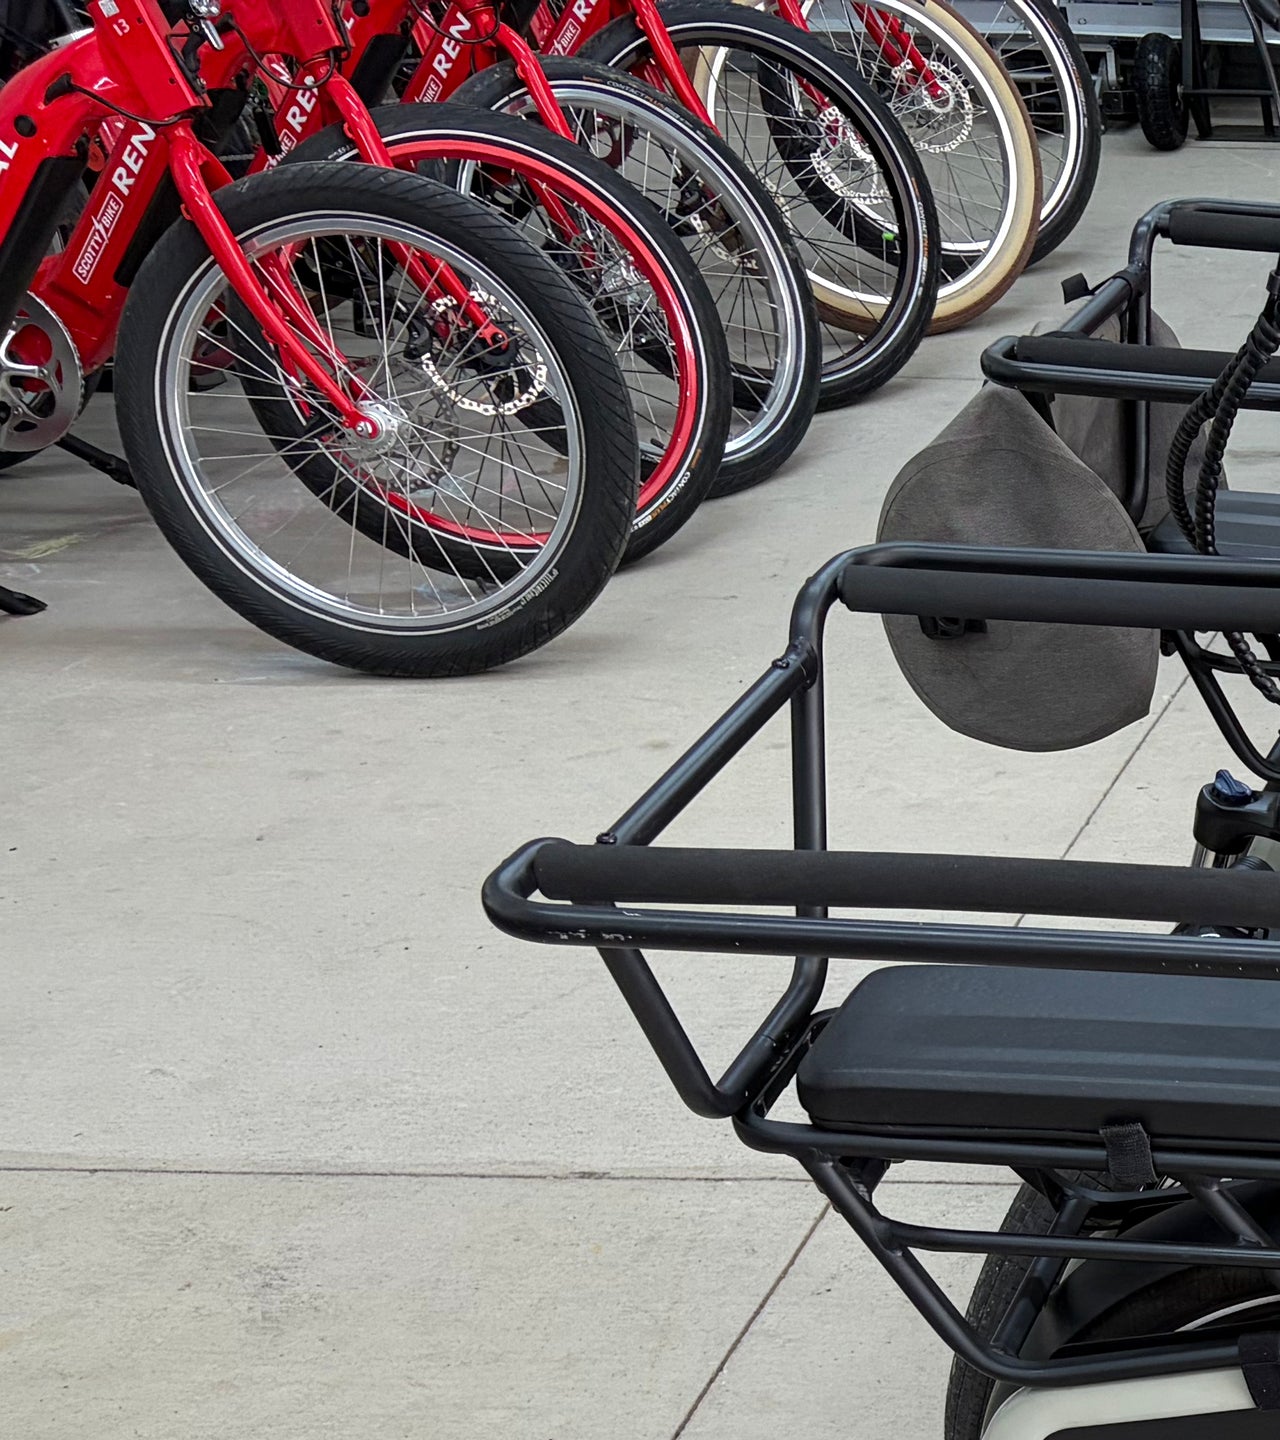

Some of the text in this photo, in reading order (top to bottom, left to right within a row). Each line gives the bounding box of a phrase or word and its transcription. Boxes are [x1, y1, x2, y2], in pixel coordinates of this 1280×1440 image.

[113, 19, 130, 36] 13
[560, 24, 577, 48] BIKE
[76, 198, 119, 278] SCOTTY BIKE
